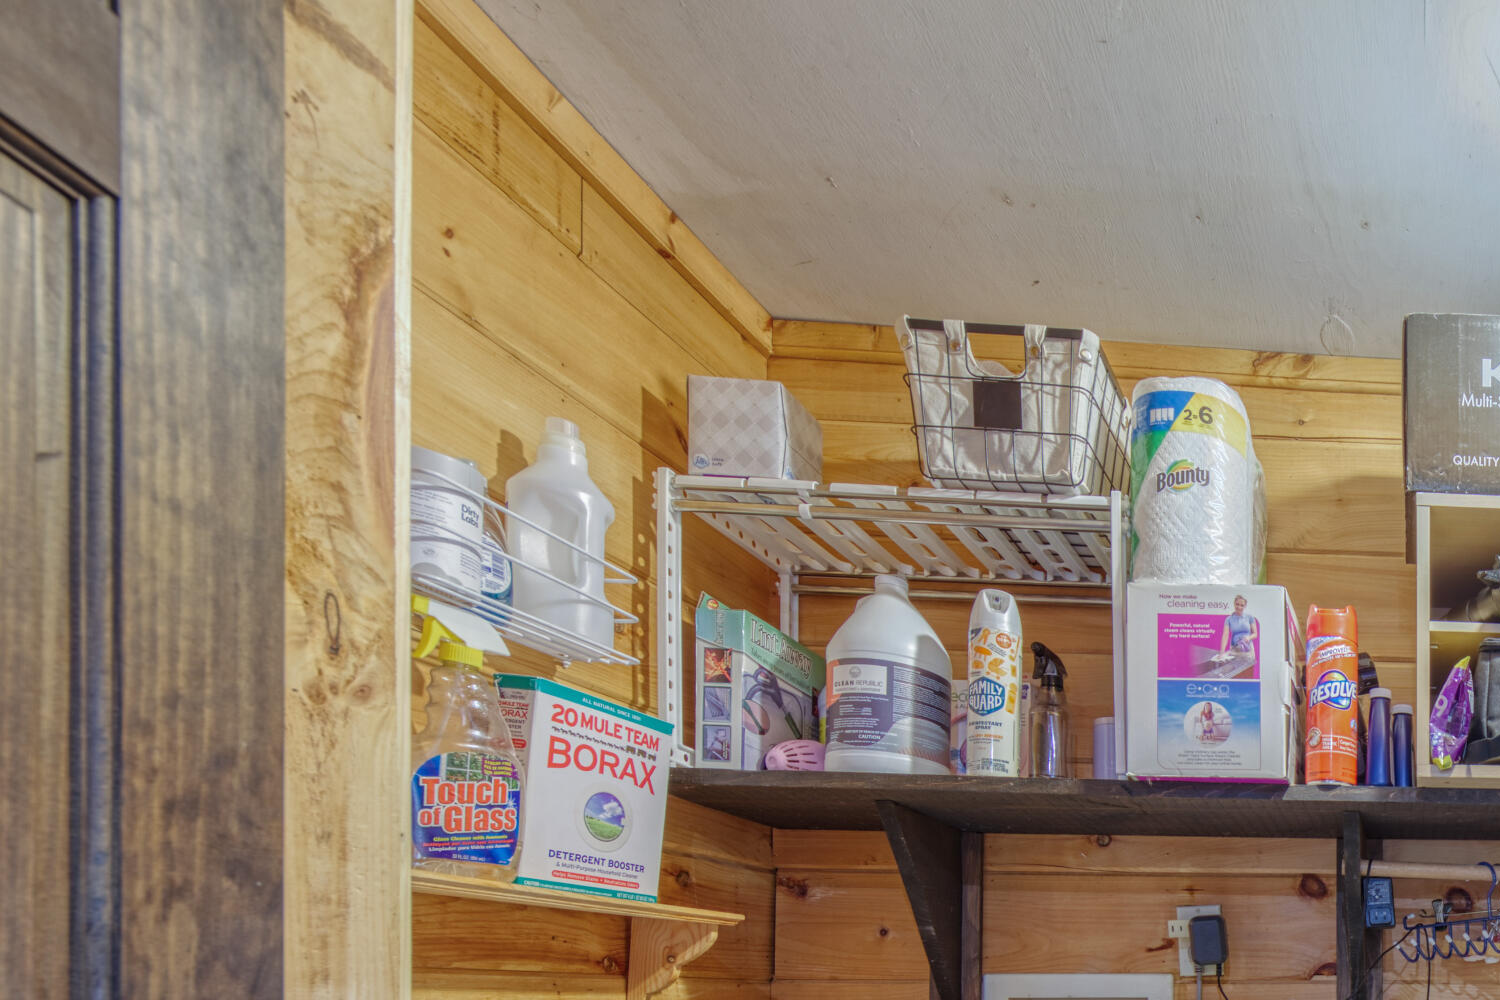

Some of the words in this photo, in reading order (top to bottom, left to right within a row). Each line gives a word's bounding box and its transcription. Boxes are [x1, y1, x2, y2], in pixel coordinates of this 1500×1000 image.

[1453, 455, 1500, 467] QUALITY
[1156, 466, 1210, 493] Bounty
[461, 503, 479, 521] Dirty
[461, 513, 479, 528] Labs
[1167, 600, 1205, 609] cleaning
[1207, 601, 1230, 609] easy.
[834, 679, 855, 687] CLEAN
[969, 681, 1003, 695] FAMILY
[969, 694, 1002, 710] GUARD
[1309, 681, 1357, 709] RESOLVE
[551, 703, 579, 727] 20
[580, 712, 623, 740] MULE
[625, 726, 660, 752] TEAM
[547, 735, 657, 796] BORAX
[421, 777, 508, 805] Touch
[420, 807, 441, 826] of
[443, 805, 516, 833] Glass
[548, 849, 606, 867] DETERGENT
[608, 859, 645, 873] BOOSTER
